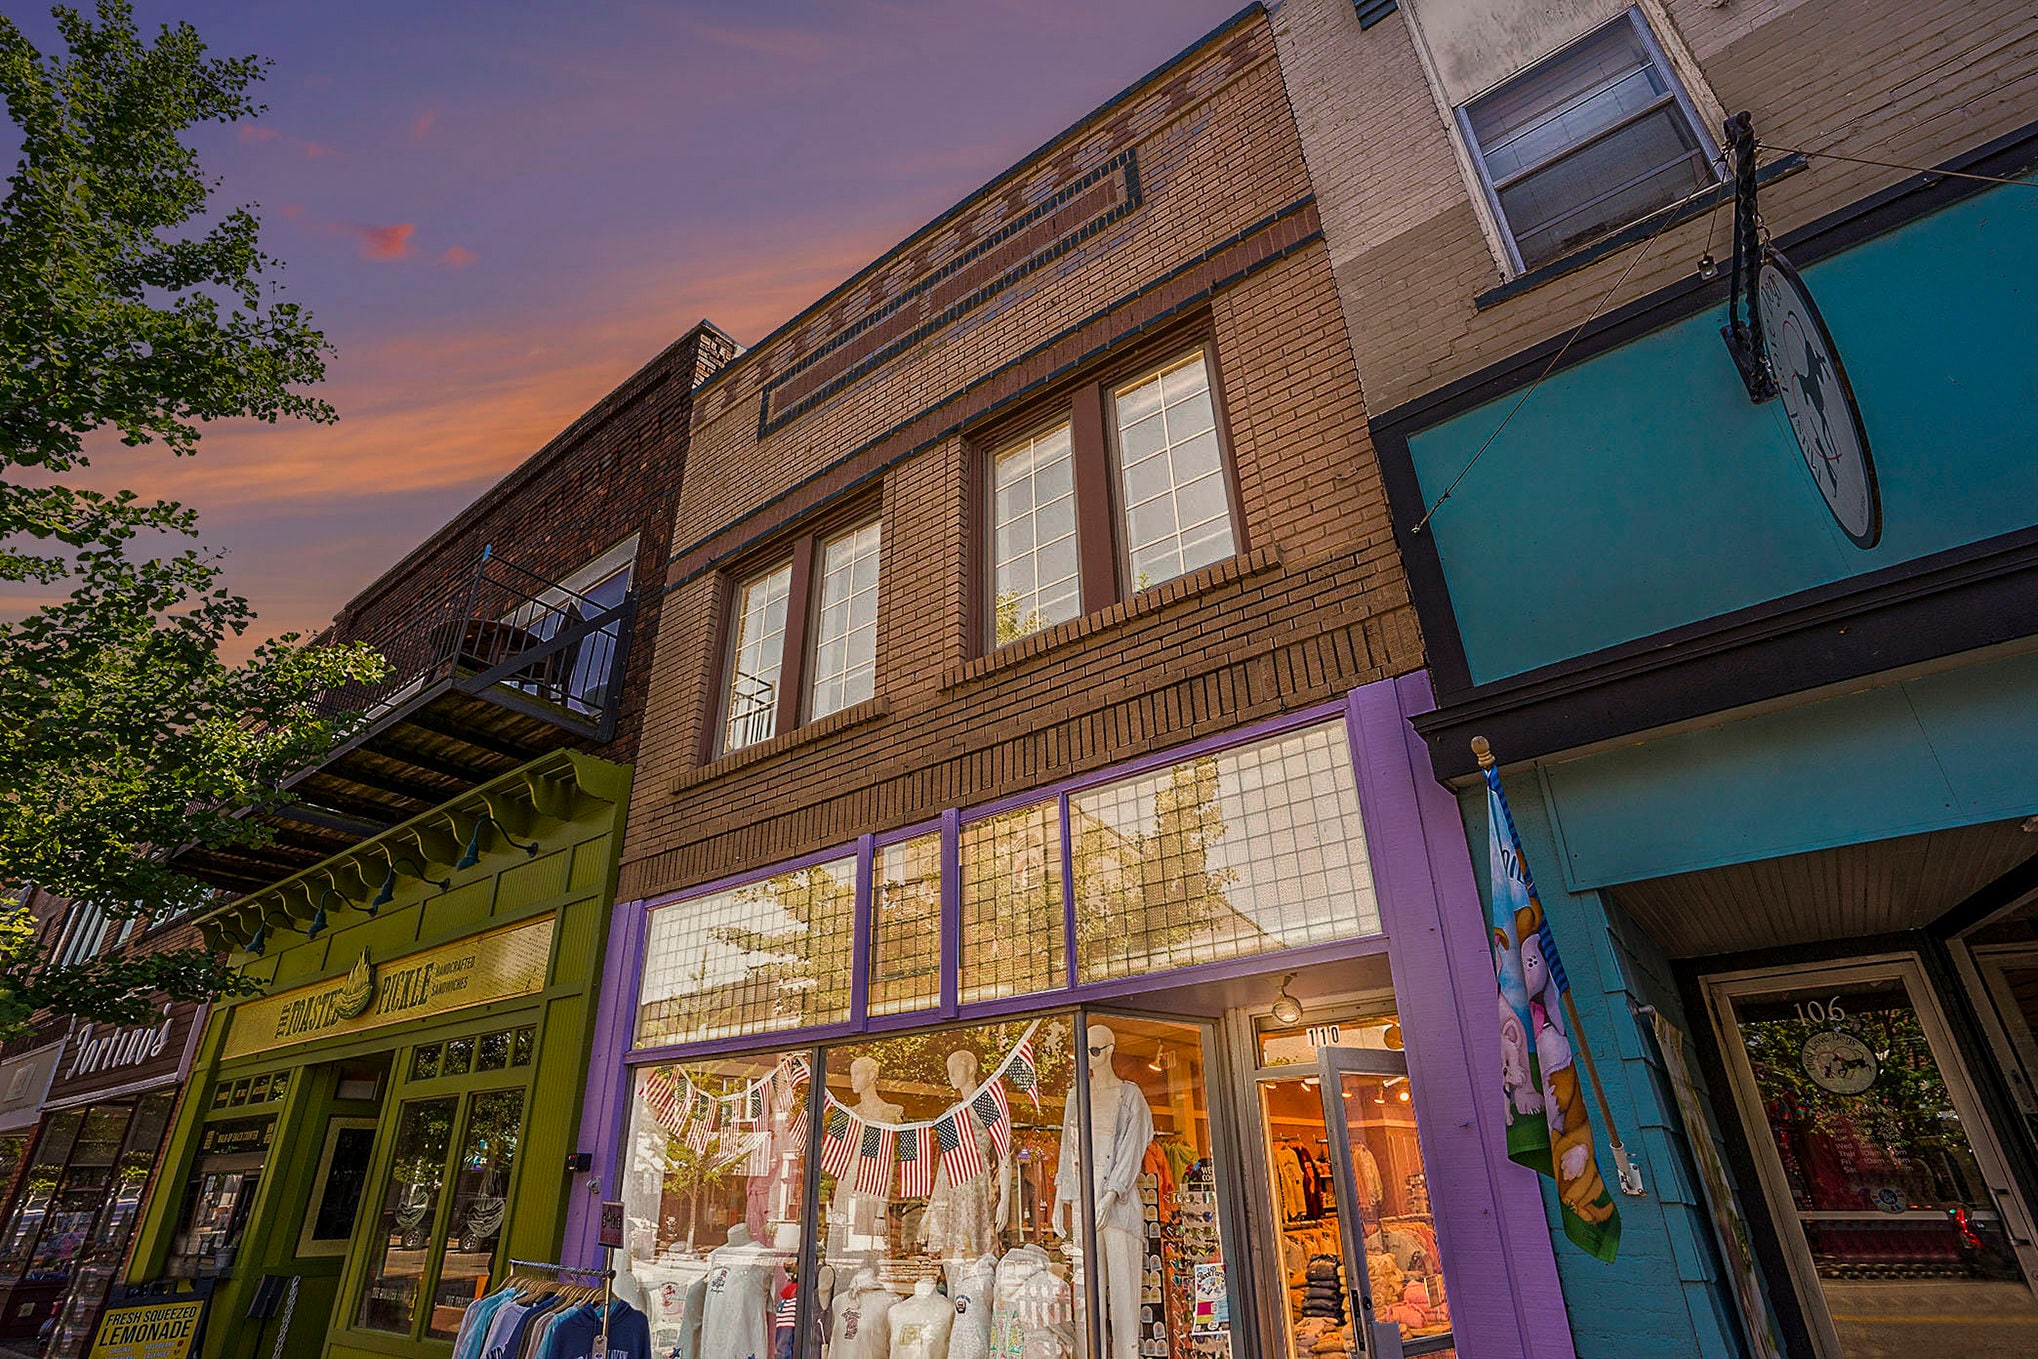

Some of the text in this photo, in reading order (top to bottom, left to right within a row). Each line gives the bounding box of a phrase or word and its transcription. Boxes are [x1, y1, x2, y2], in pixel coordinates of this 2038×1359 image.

[376, 963, 434, 1015] PICKLE
[431, 976, 469, 997] SANDWICHES
[1793, 996, 1845, 1027] 106
[1309, 1027, 1339, 1046] 110
[106, 1306, 197, 1326] FRESH SQUEEZED
[99, 1320, 194, 1347] LEMONADE
